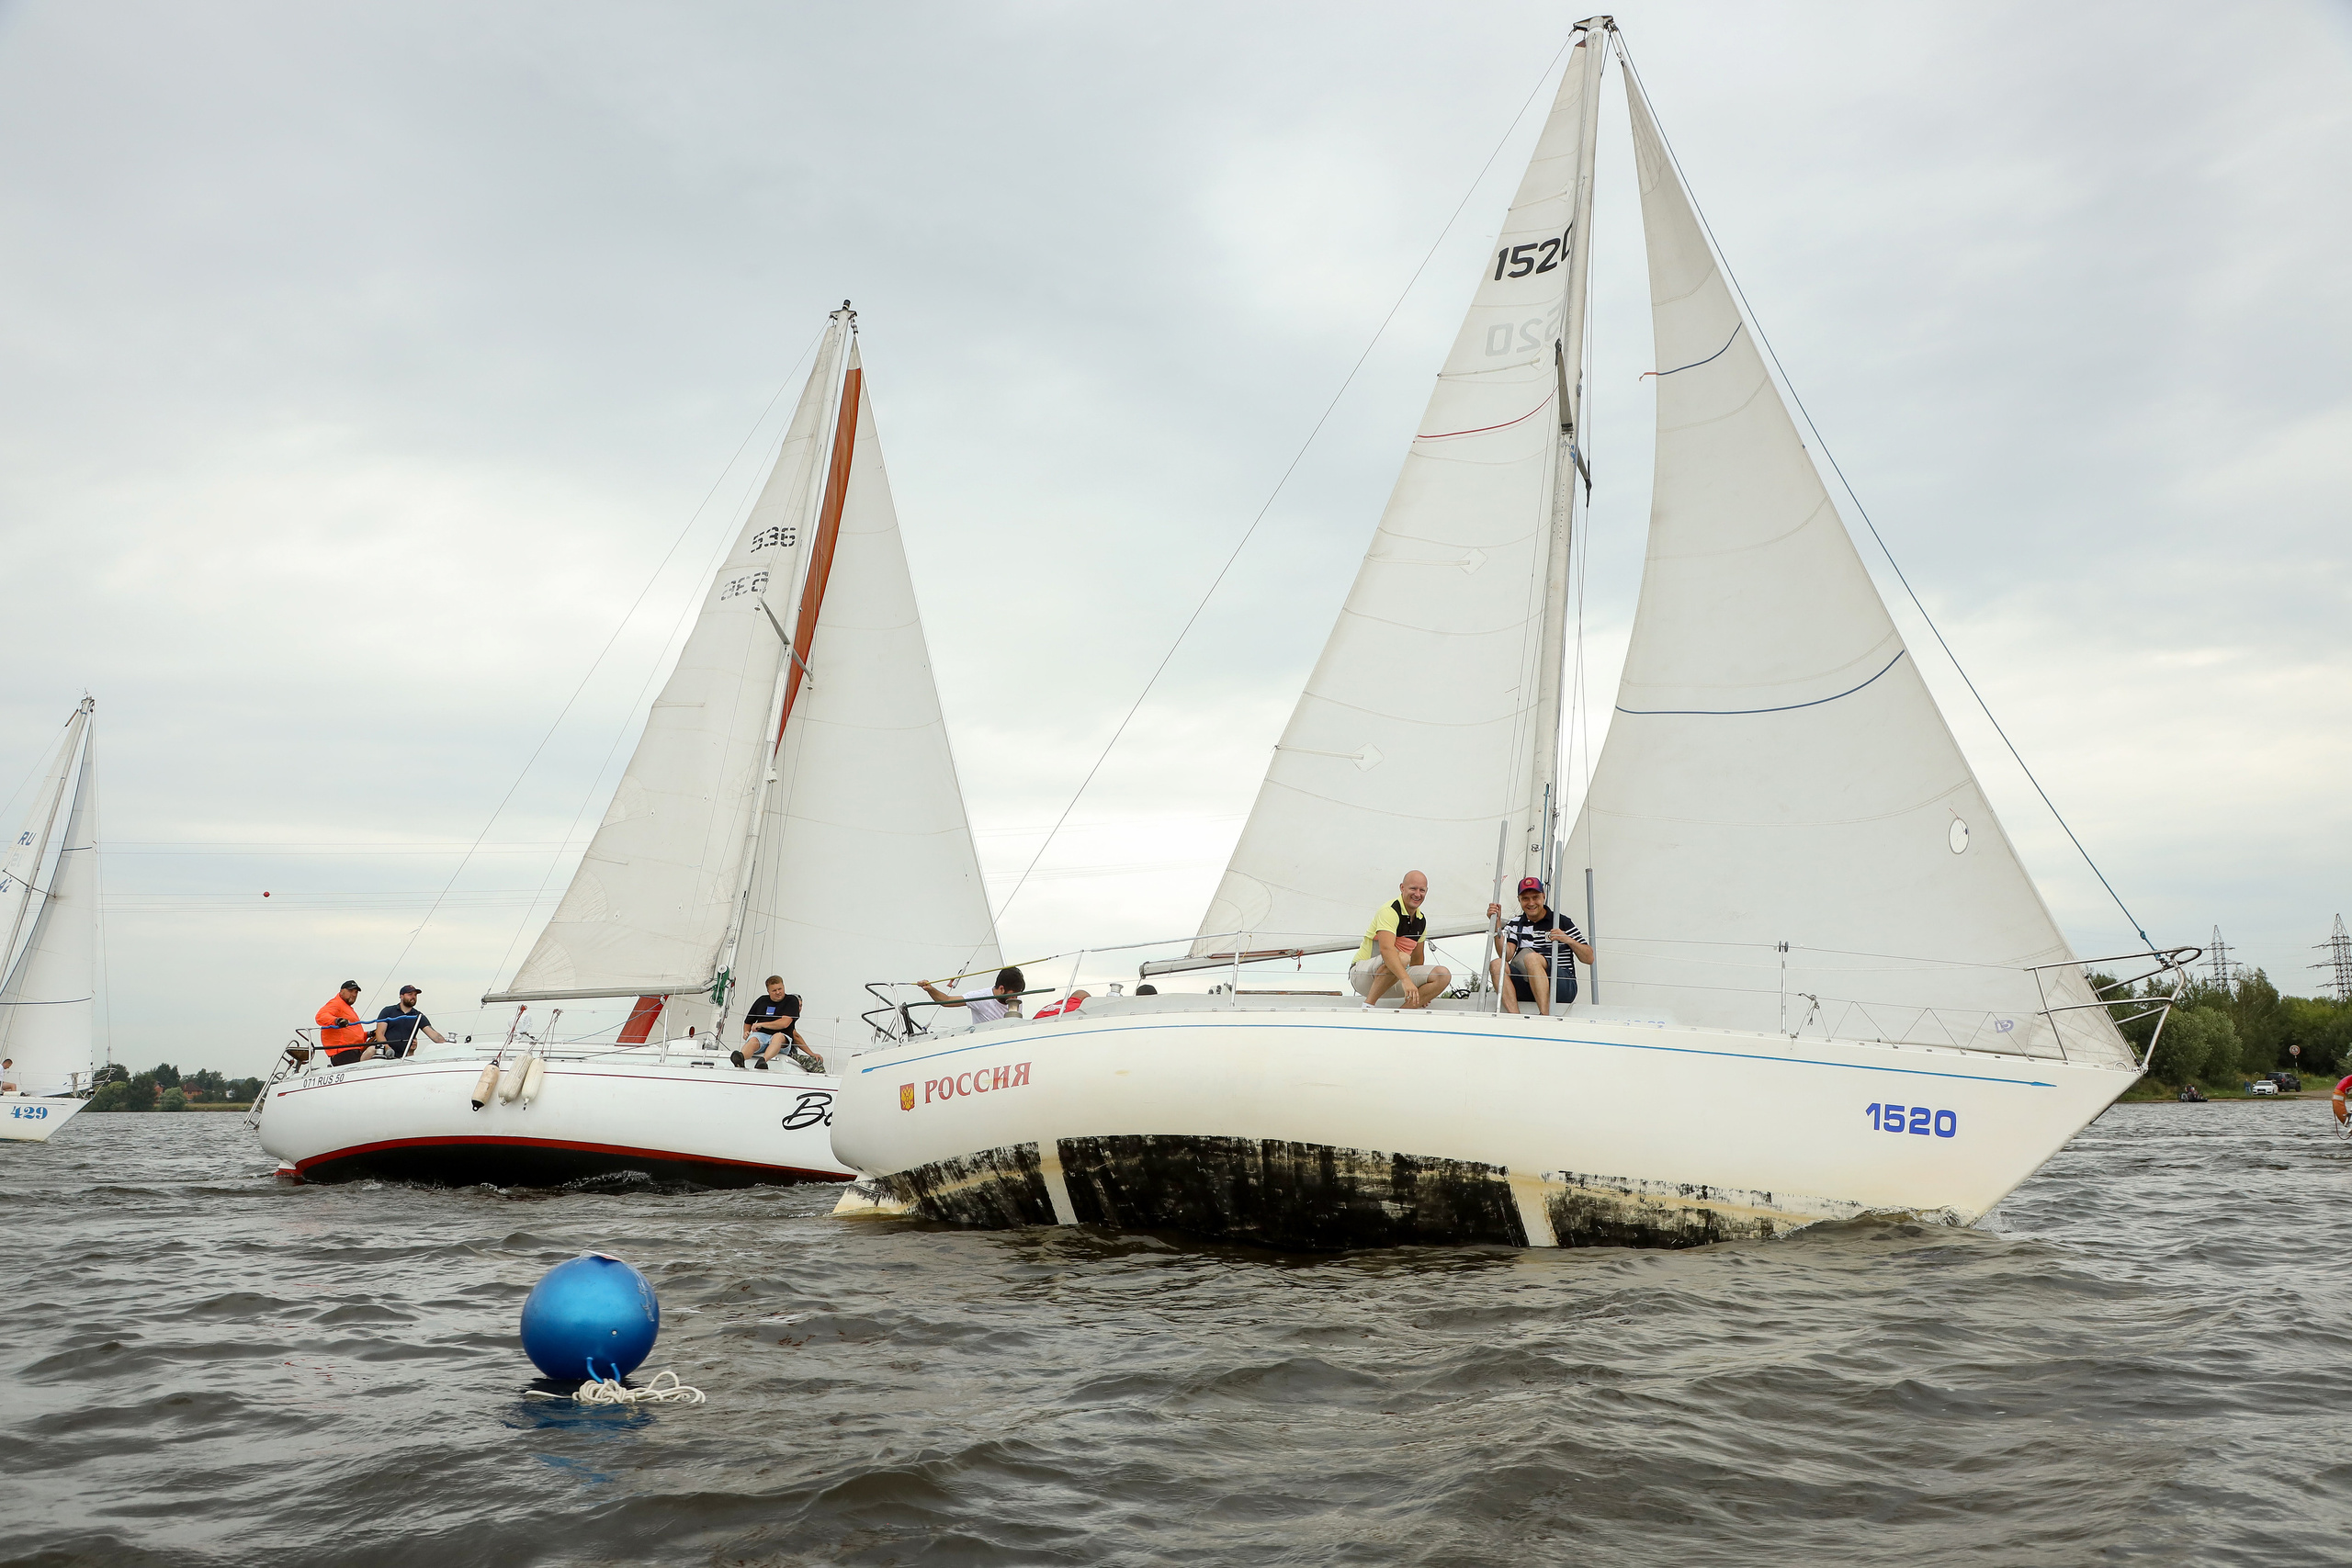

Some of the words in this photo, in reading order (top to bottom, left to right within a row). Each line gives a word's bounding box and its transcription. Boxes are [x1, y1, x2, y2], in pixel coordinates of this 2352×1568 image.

[751, 526, 796, 553] 536
[302, 1077, 316, 1089] 071
[317, 1075, 334, 1086] RUS
[334, 1073, 345, 1083] 50
[924, 1061, 1032, 1104] РОССИЯ
[10, 1106, 48, 1120] 429
[1865, 1102, 1957, 1138] 1520
